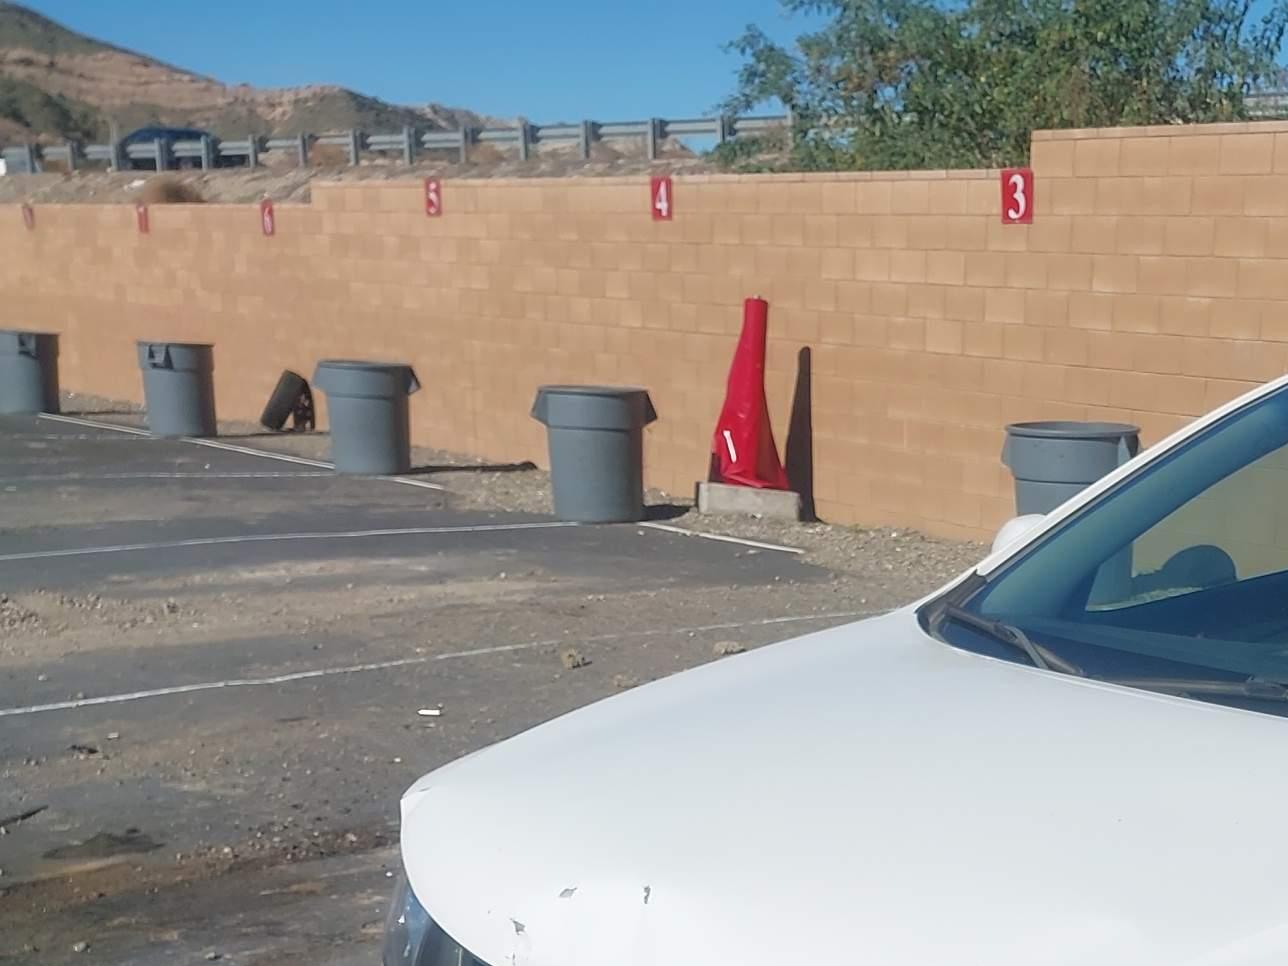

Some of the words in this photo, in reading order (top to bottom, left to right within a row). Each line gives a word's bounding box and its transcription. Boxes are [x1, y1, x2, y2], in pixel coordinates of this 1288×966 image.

[428, 181, 438, 214] 5
[655, 181, 668, 217] 4
[1008, 174, 1026, 219] 3
